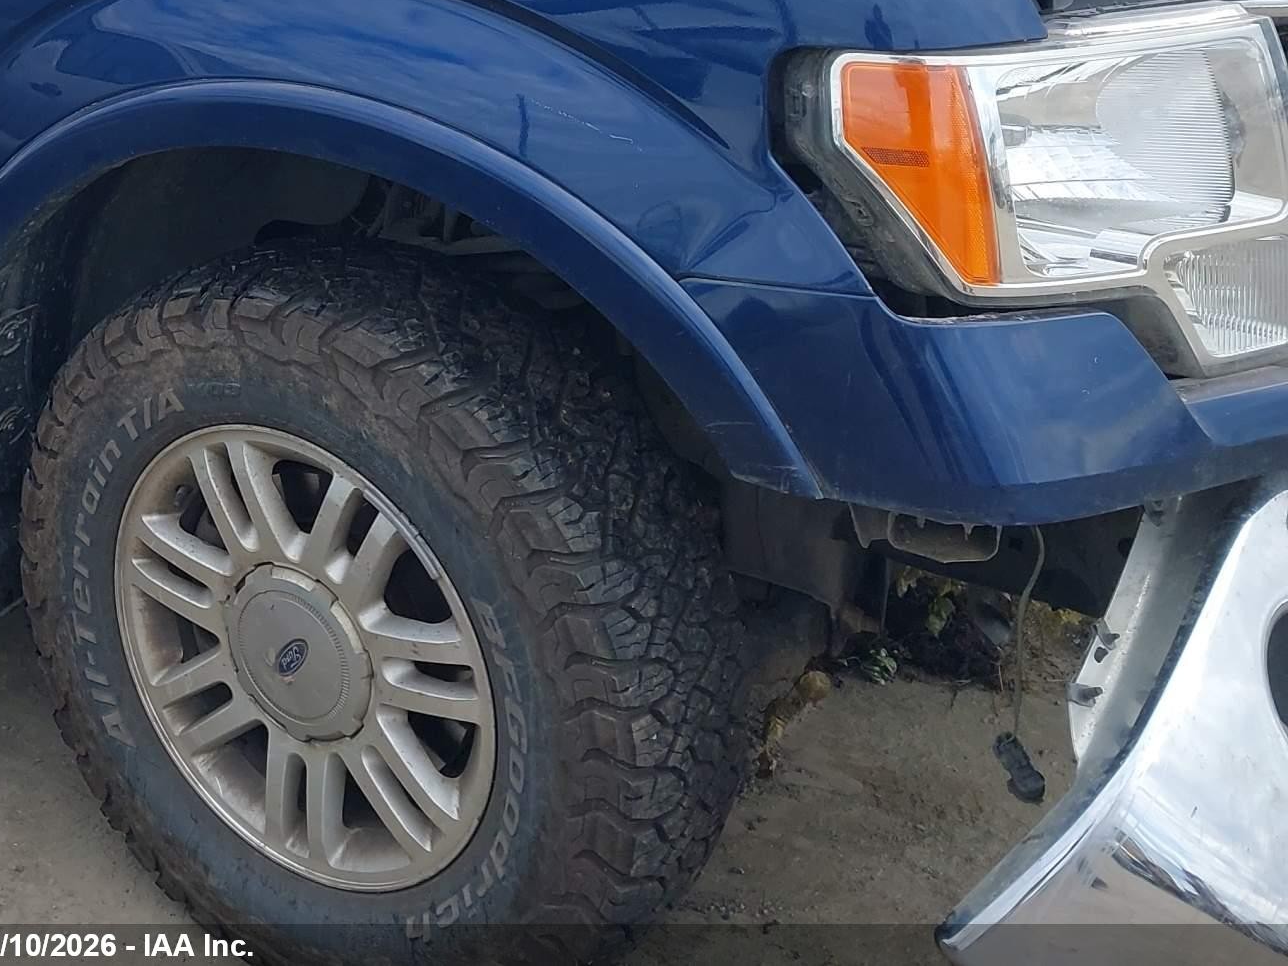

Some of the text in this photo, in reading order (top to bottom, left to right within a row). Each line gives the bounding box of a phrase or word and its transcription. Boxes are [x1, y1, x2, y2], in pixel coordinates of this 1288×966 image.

[117, 388, 185, 441] T/A
[281, 645, 302, 671] Ford
[406, 596, 528, 942] BFGoodrich
